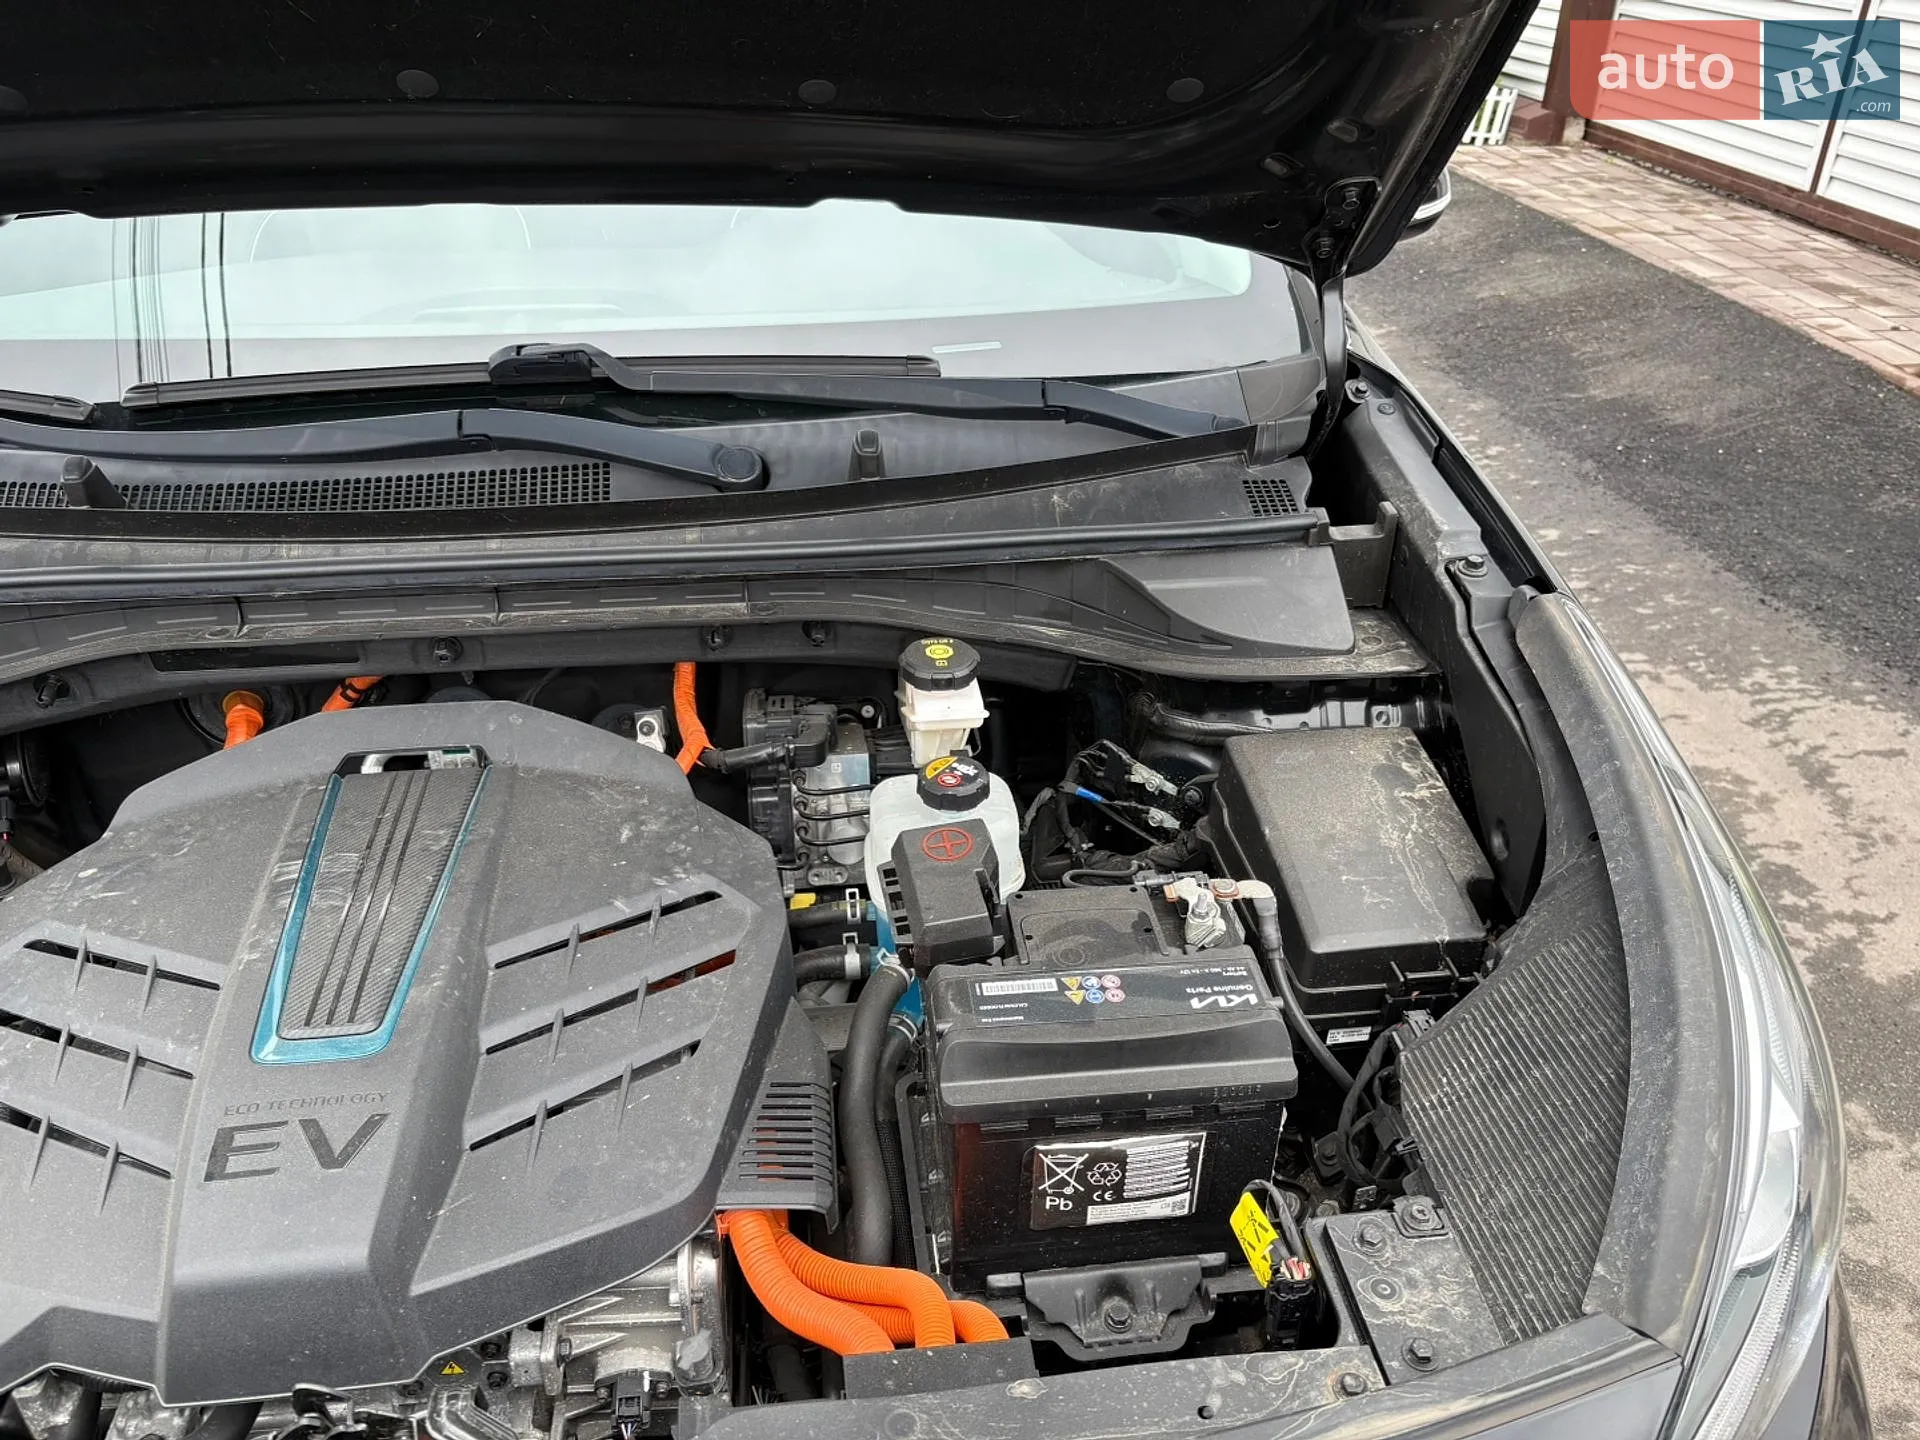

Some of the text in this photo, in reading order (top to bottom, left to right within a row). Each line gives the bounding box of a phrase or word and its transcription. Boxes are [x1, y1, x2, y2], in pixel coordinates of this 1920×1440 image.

[1185, 983, 1254, 995] Genuine Parts
[223, 1091, 390, 1118] ECO TECHNOLOGY
[203, 1111, 392, 1183] EV
[1044, 1195, 1074, 1212] Pb
